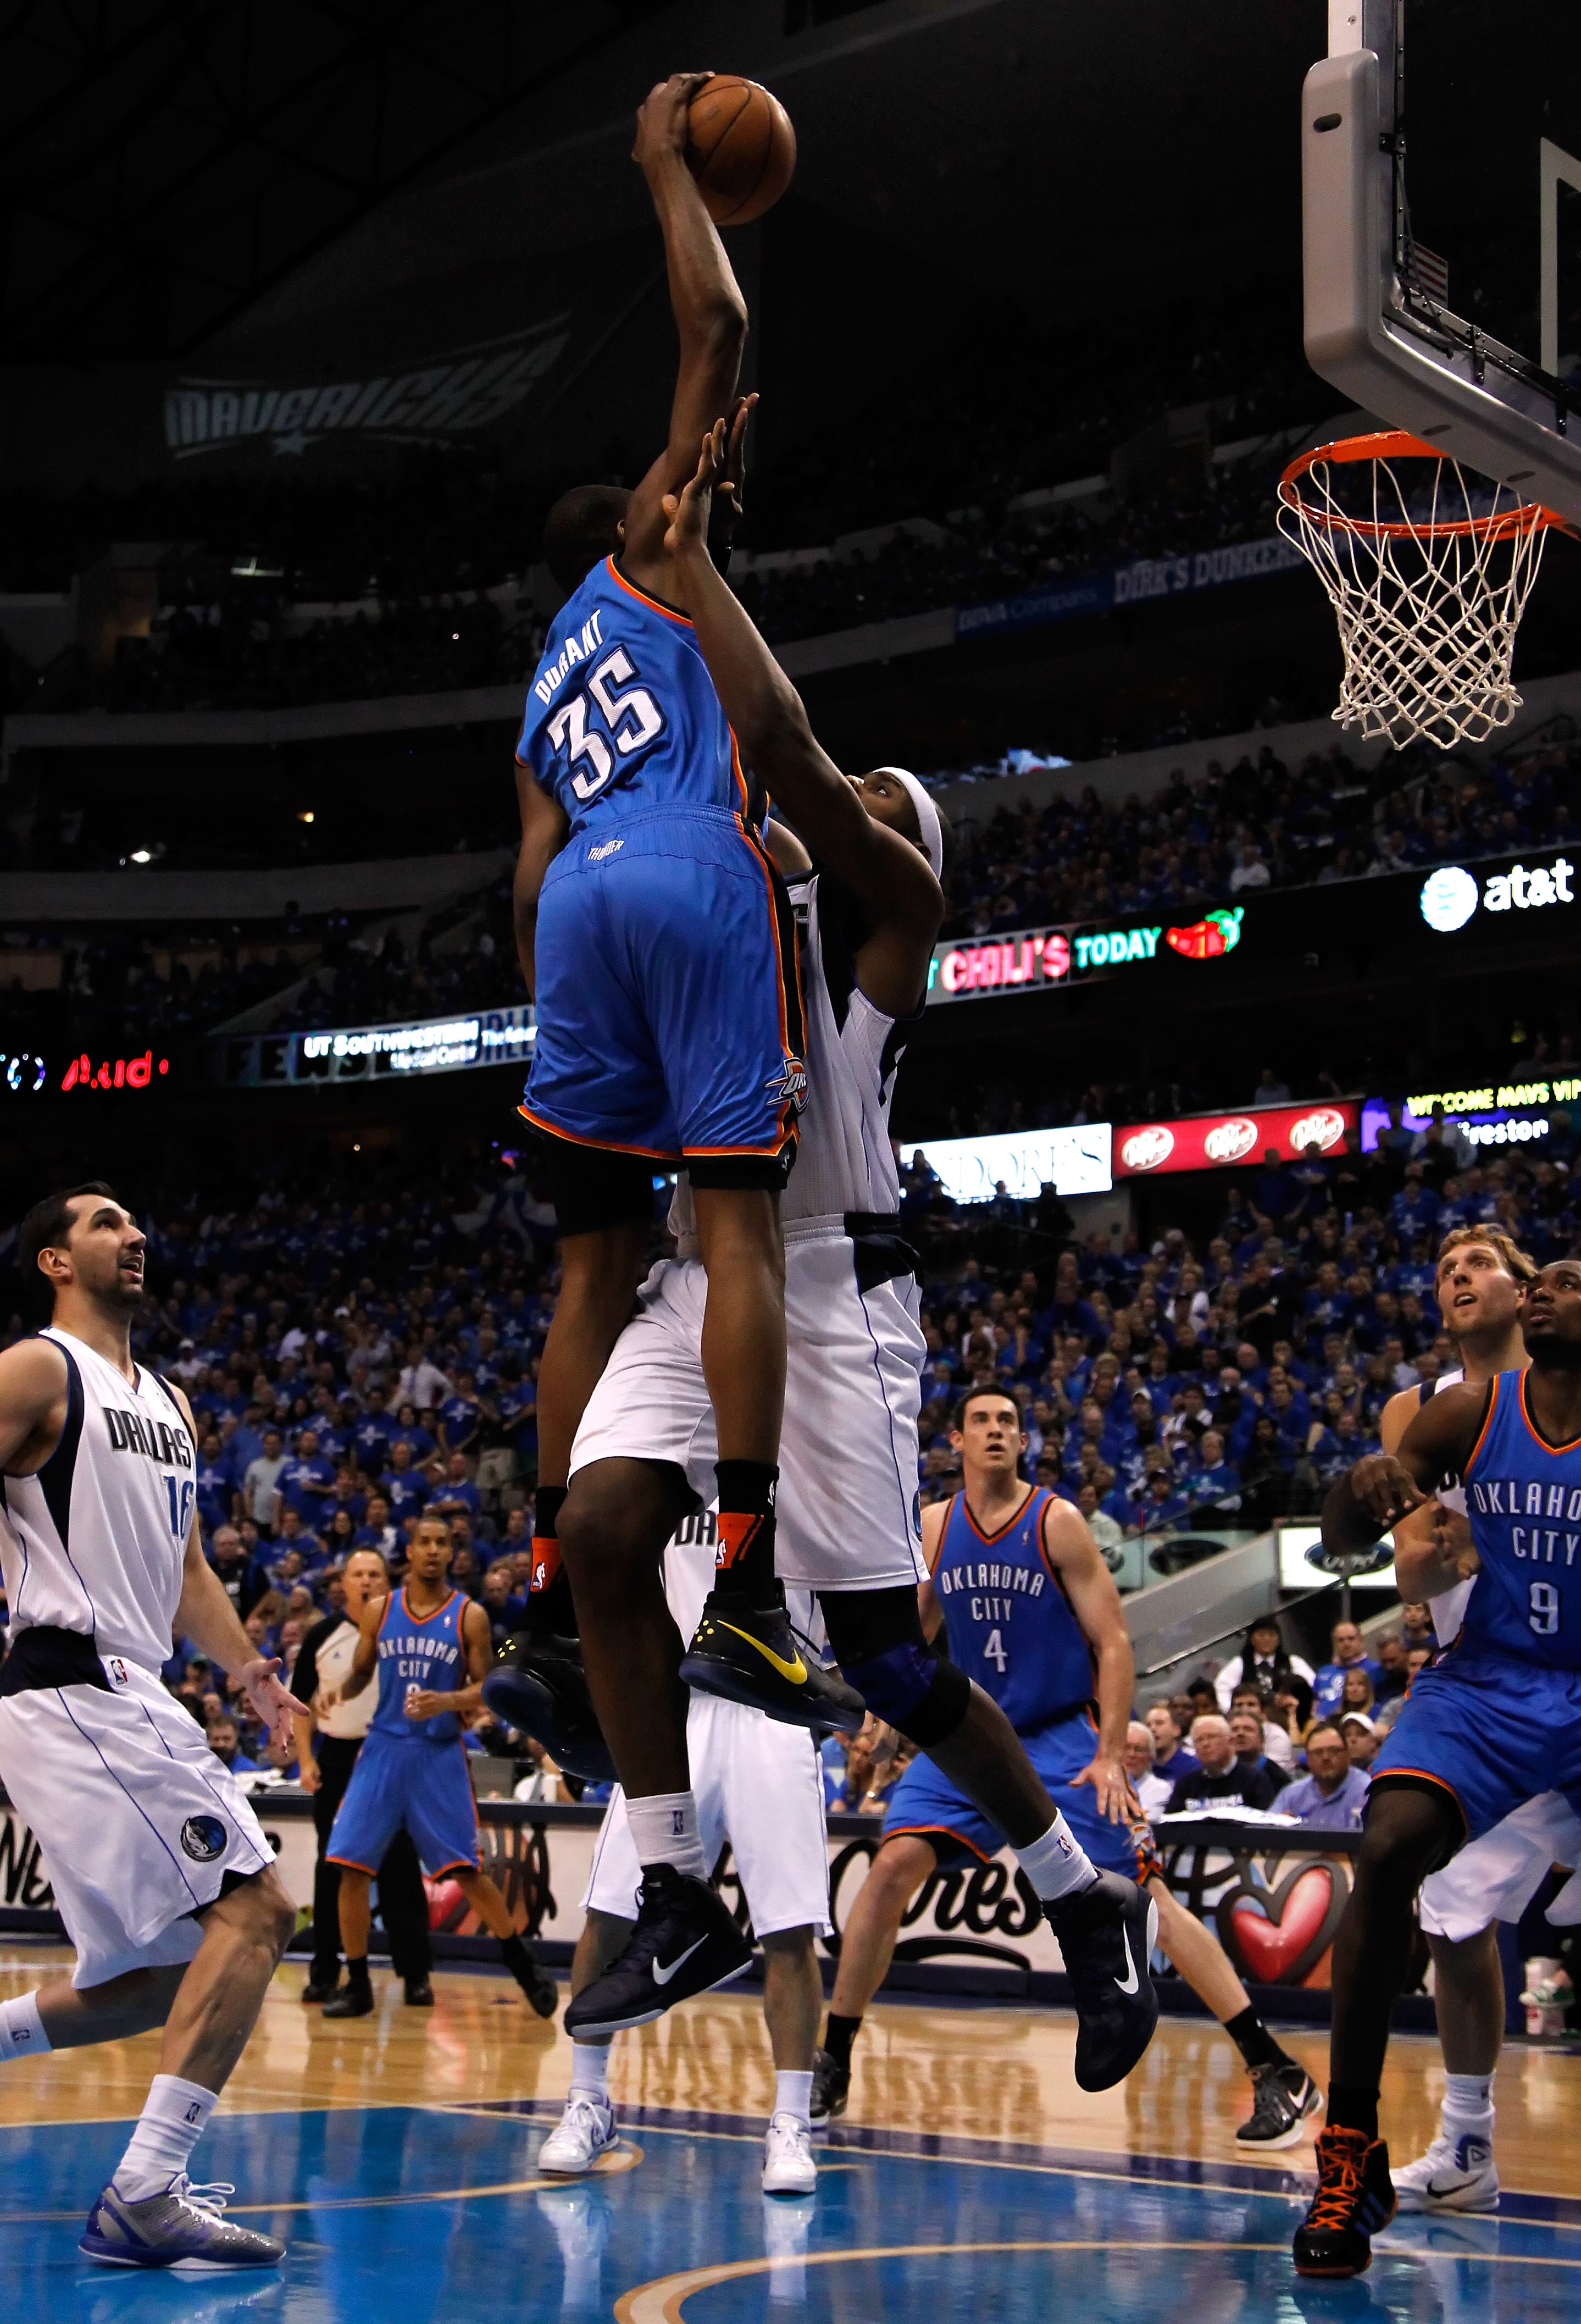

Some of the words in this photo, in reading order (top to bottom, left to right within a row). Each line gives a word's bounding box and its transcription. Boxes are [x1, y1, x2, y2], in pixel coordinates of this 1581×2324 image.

[165, 331, 570, 448] MAVERICKS
[534, 609, 604, 706] DURANT
[546, 643, 668, 804] 35
[587, 839, 625, 861] THUNDER
[1483, 858, 1574, 911] at&t
[941, 934, 1070, 992] CHILI'S
[1074, 927, 1162, 969] TODAY
[304, 1036, 332, 1058] UT
[101, 1407, 191, 1471] DALLAS
[1512, 1525, 1580, 1566] CITY
[940, 1563, 1045, 1598] OKLAHOMA
[970, 1596, 1012, 1623] CITY
[1529, 1581, 1559, 1635] 9
[379, 1636, 459, 1665] OKLAHOMA
[398, 1659, 431, 1679] CITY
[983, 1628, 1008, 1673] 4
[824, 1839, 1042, 1960] Cres
